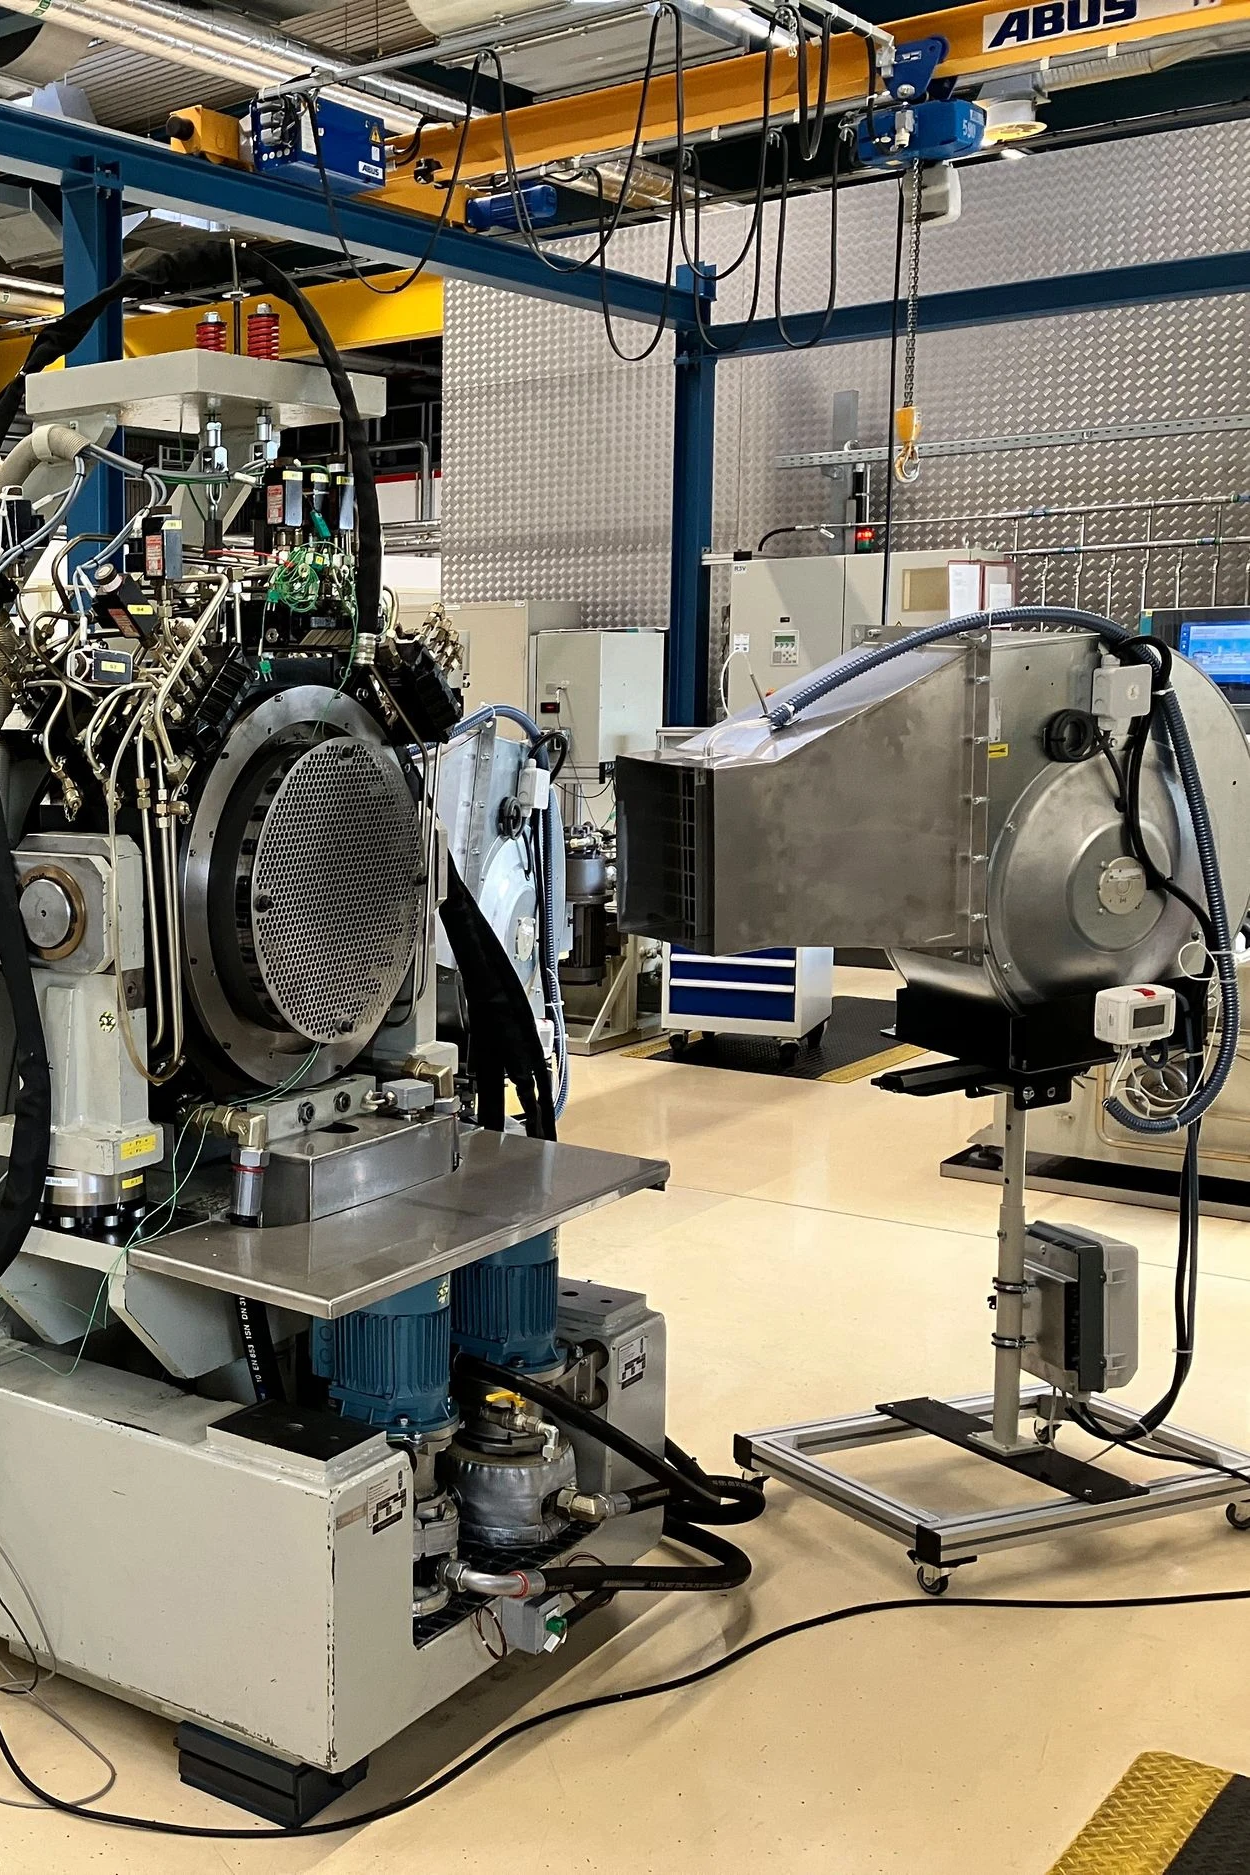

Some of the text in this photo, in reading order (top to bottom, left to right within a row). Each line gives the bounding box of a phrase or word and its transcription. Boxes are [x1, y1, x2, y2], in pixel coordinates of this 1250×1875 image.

[987, 0, 1138, 49] ABUS
[361, 164, 380, 176] ABUS
[240, 1307, 249, 1320] DN
[250, 1359, 260, 1371] EN
